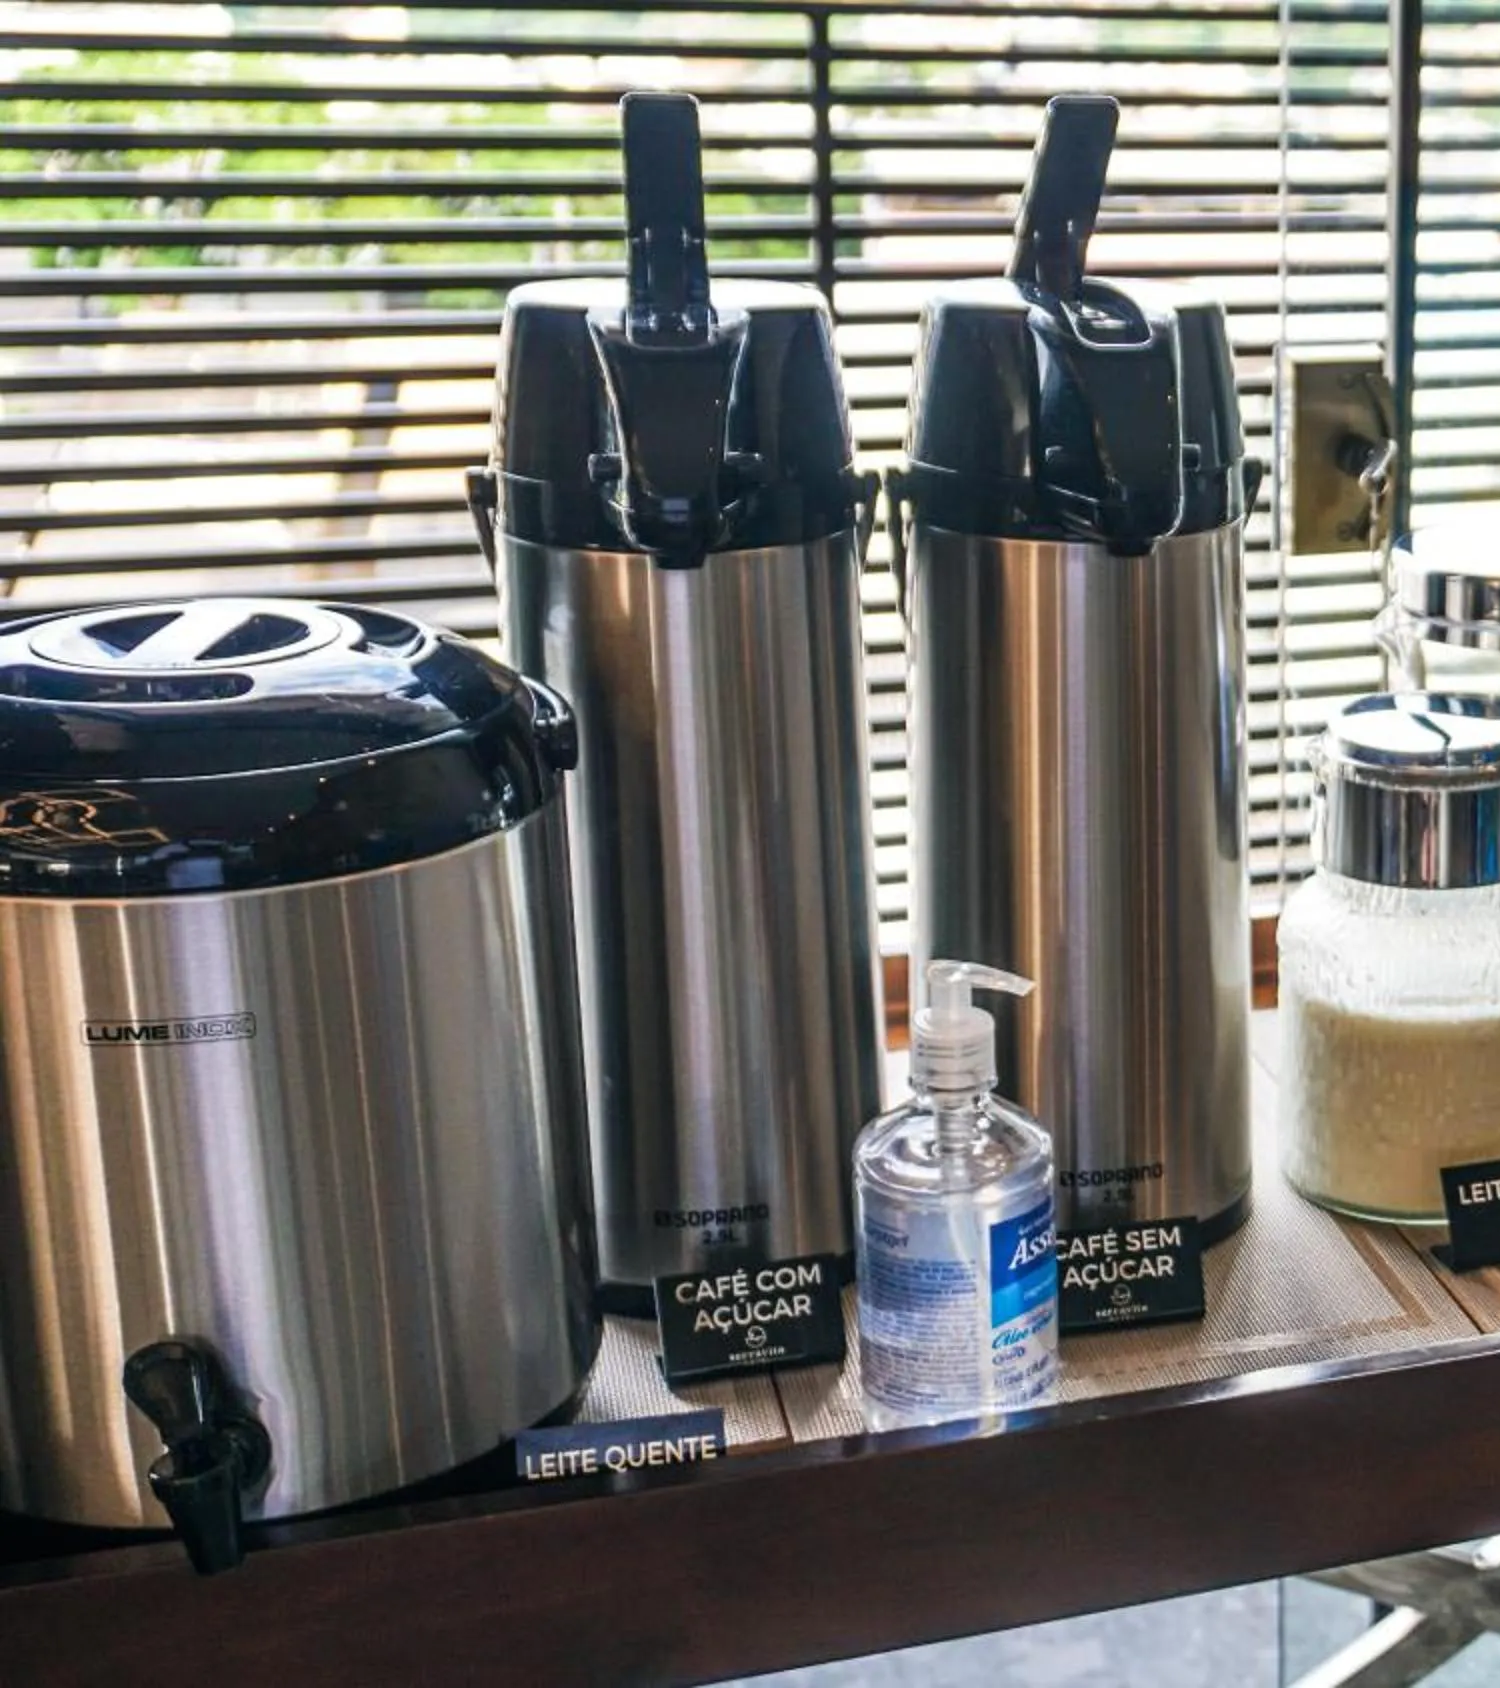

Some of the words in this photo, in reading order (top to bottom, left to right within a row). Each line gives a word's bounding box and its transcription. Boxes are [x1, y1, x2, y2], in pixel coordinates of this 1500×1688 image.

[86, 1025, 170, 1042] LUME
[1056, 1227, 1119, 1260] CAFÉ
[1125, 1226, 1182, 1251] SEM
[675, 1268, 749, 1304] CAFÉ
[756, 1263, 821, 1291] COM
[1063, 1256, 1174, 1290] AÇÚCAR
[694, 1294, 812, 1334] AÇÚCAR
[526, 1448, 598, 1480] LEITE
[604, 1435, 717, 1472] QUENTE
